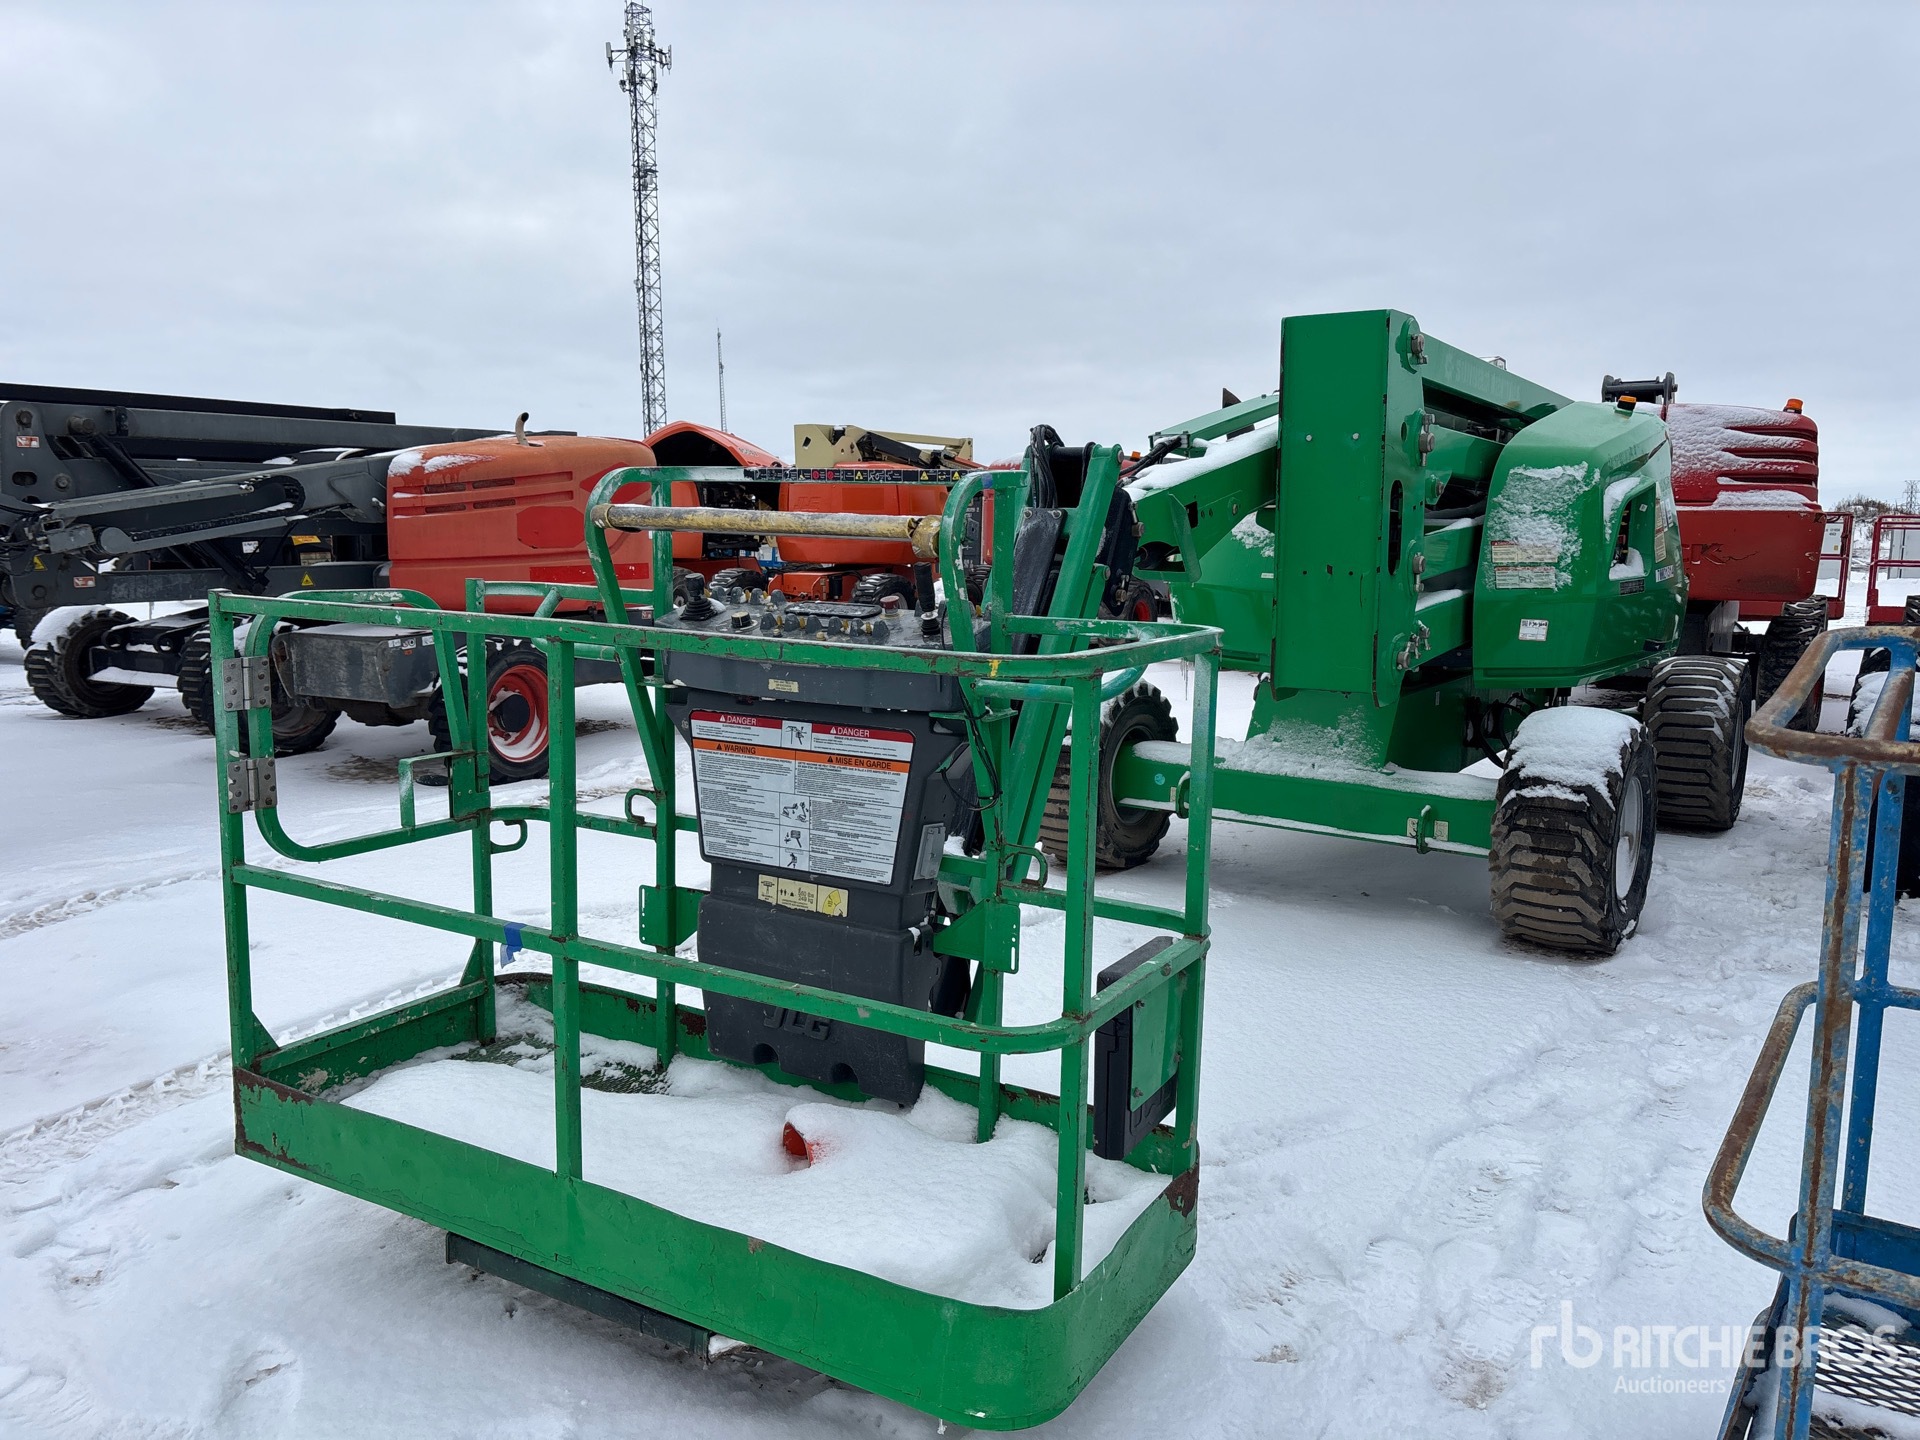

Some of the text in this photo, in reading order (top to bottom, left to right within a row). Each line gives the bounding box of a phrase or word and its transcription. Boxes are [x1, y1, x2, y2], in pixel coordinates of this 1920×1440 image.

[727, 715, 757, 725] DANGER
[837, 726, 870, 737] DANGER
[724, 743, 756, 754] WARNING
[835, 757, 892, 769] MISE EN GARDE
